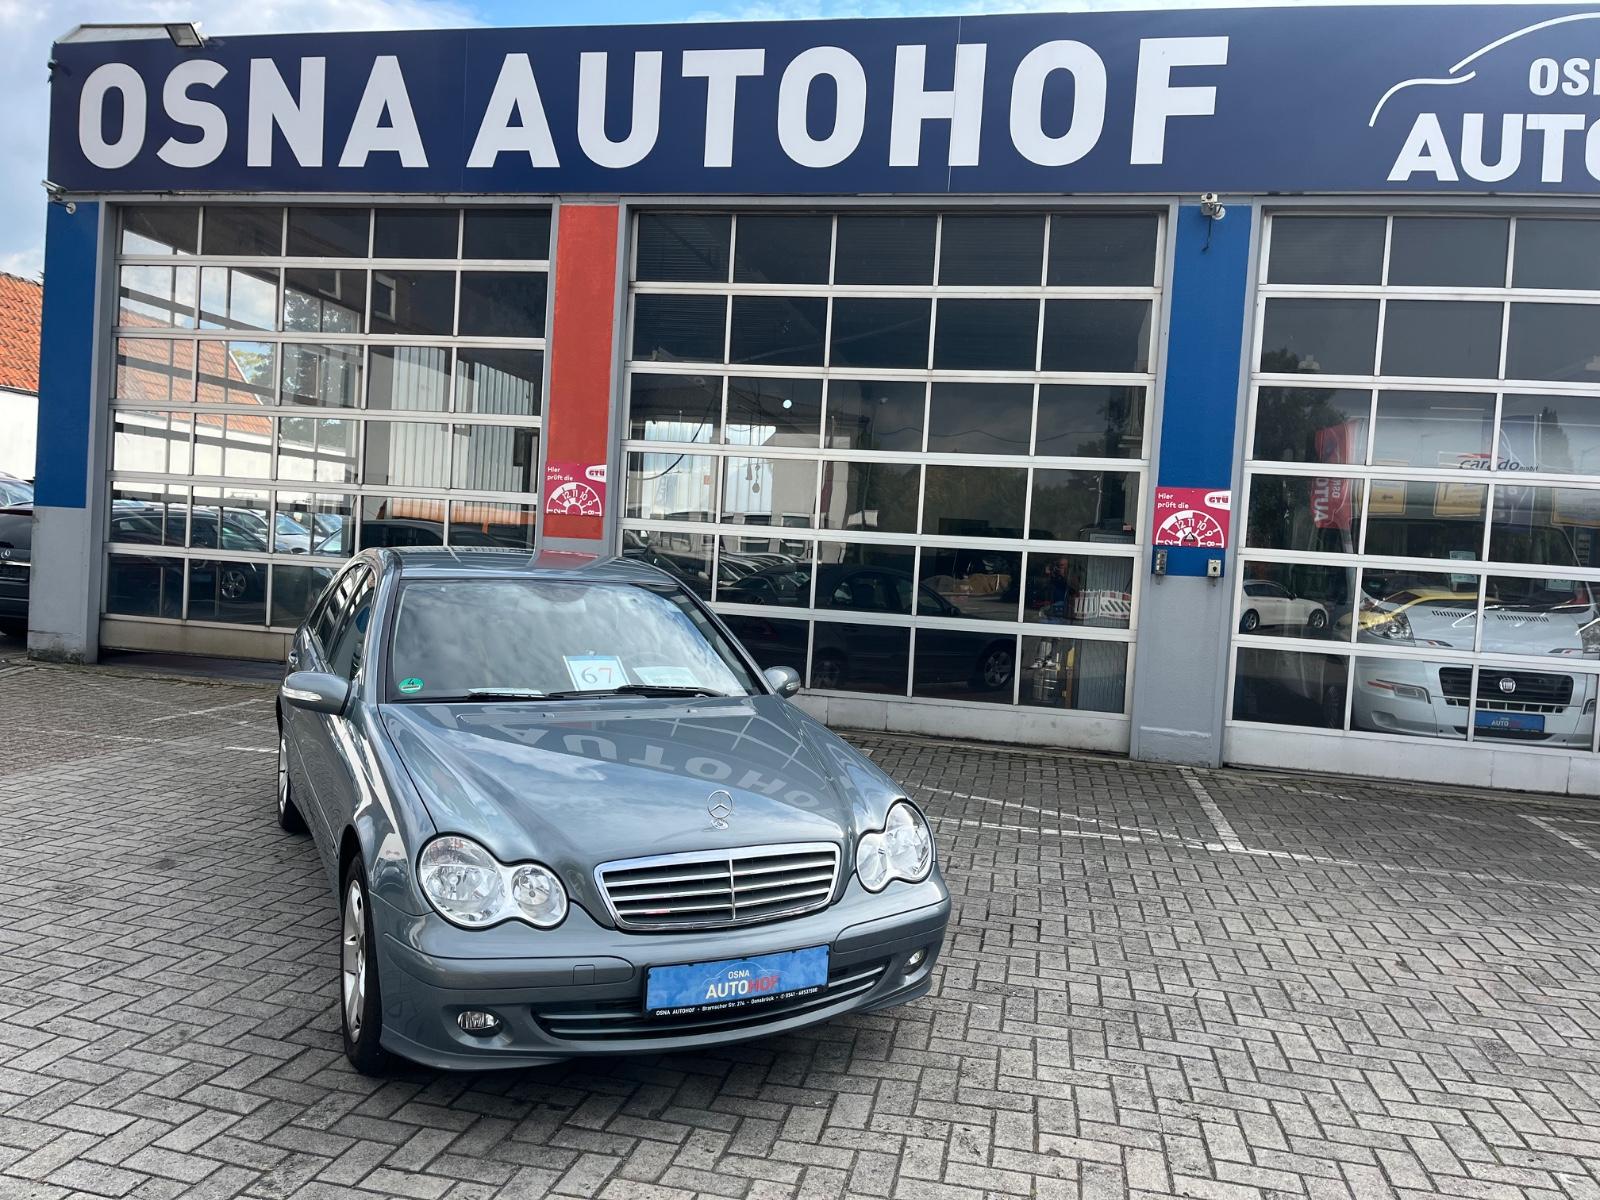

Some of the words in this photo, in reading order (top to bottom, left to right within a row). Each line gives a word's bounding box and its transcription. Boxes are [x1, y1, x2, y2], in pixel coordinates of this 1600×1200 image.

[1529, 58, 1600, 97] OS
[79, 56, 428, 168] OSNA
[467, 36, 1229, 168] AUTOHOF
[1387, 113, 1600, 182] AUT
[1209, 495, 1229, 503] GTÜ
[581, 667, 613, 684] 67
[728, 969, 750, 979] OSNA
[705, 975, 779, 999] AUTOHOF
[656, 1008, 671, 1016] OSNA
[672, 1007, 695, 1015] AUTOHOF
